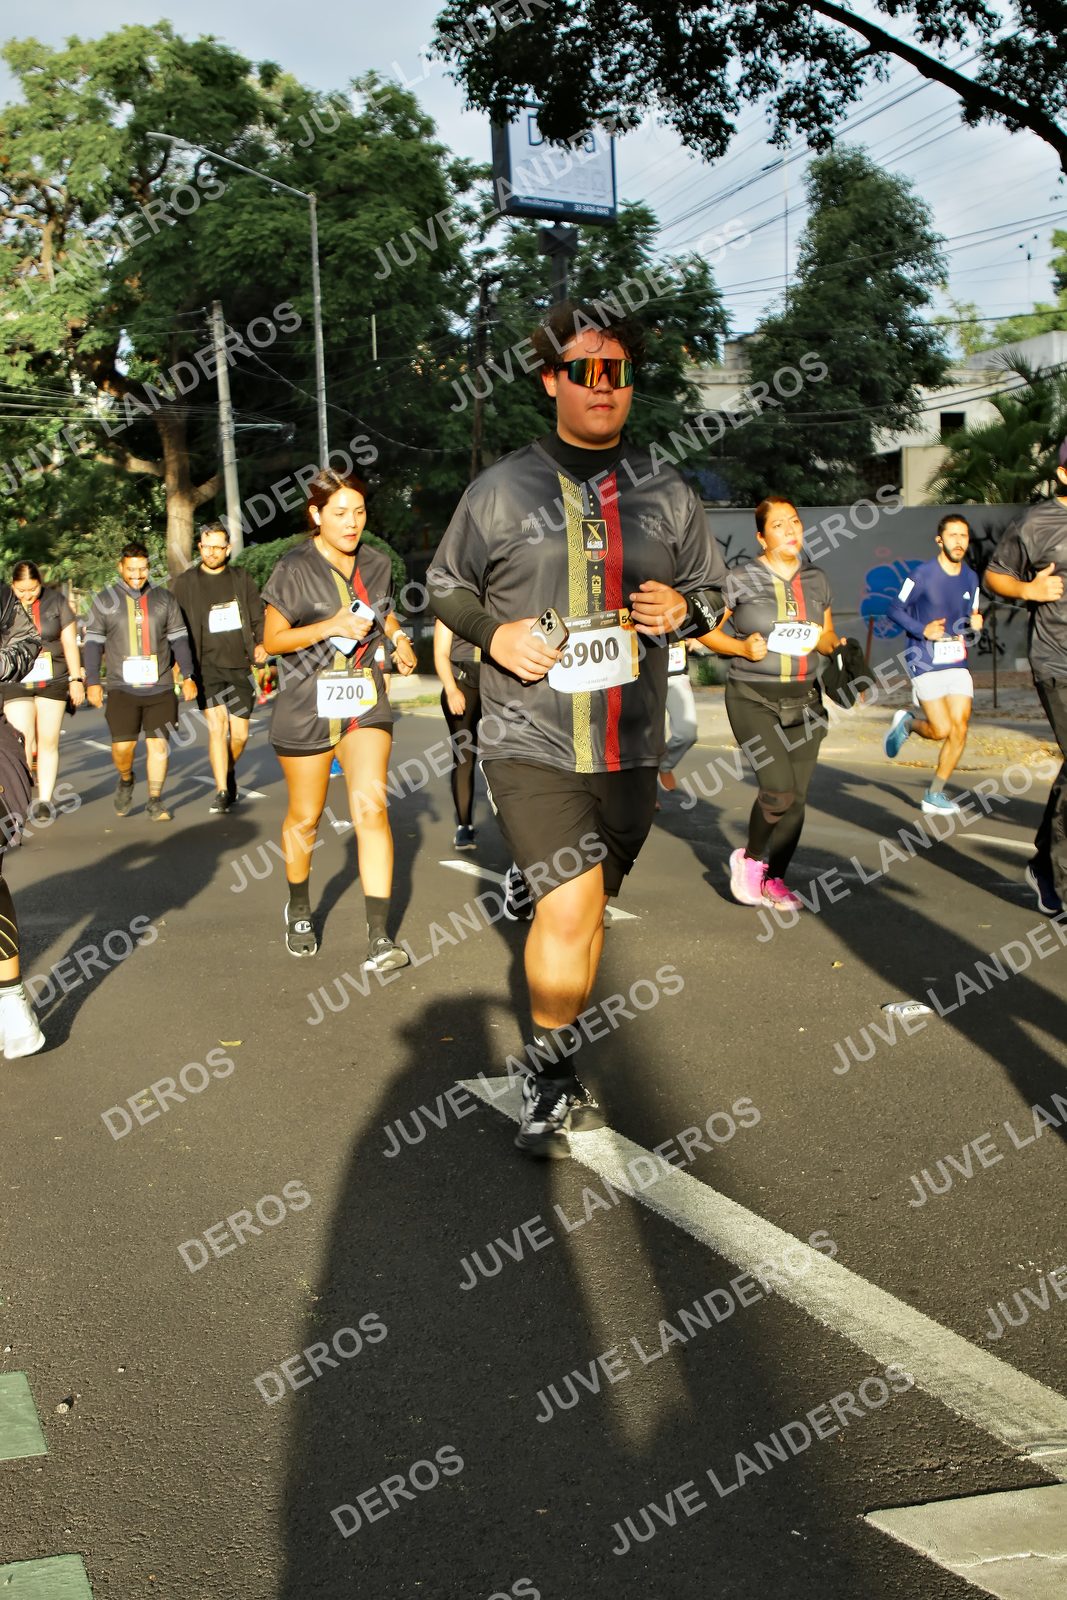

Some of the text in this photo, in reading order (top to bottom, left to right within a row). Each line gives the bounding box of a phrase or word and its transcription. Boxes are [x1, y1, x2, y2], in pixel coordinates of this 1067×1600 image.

[777, 627, 812, 641] 2039
[560, 637, 620, 669] 6900
[326, 685, 364, 701] 7200
